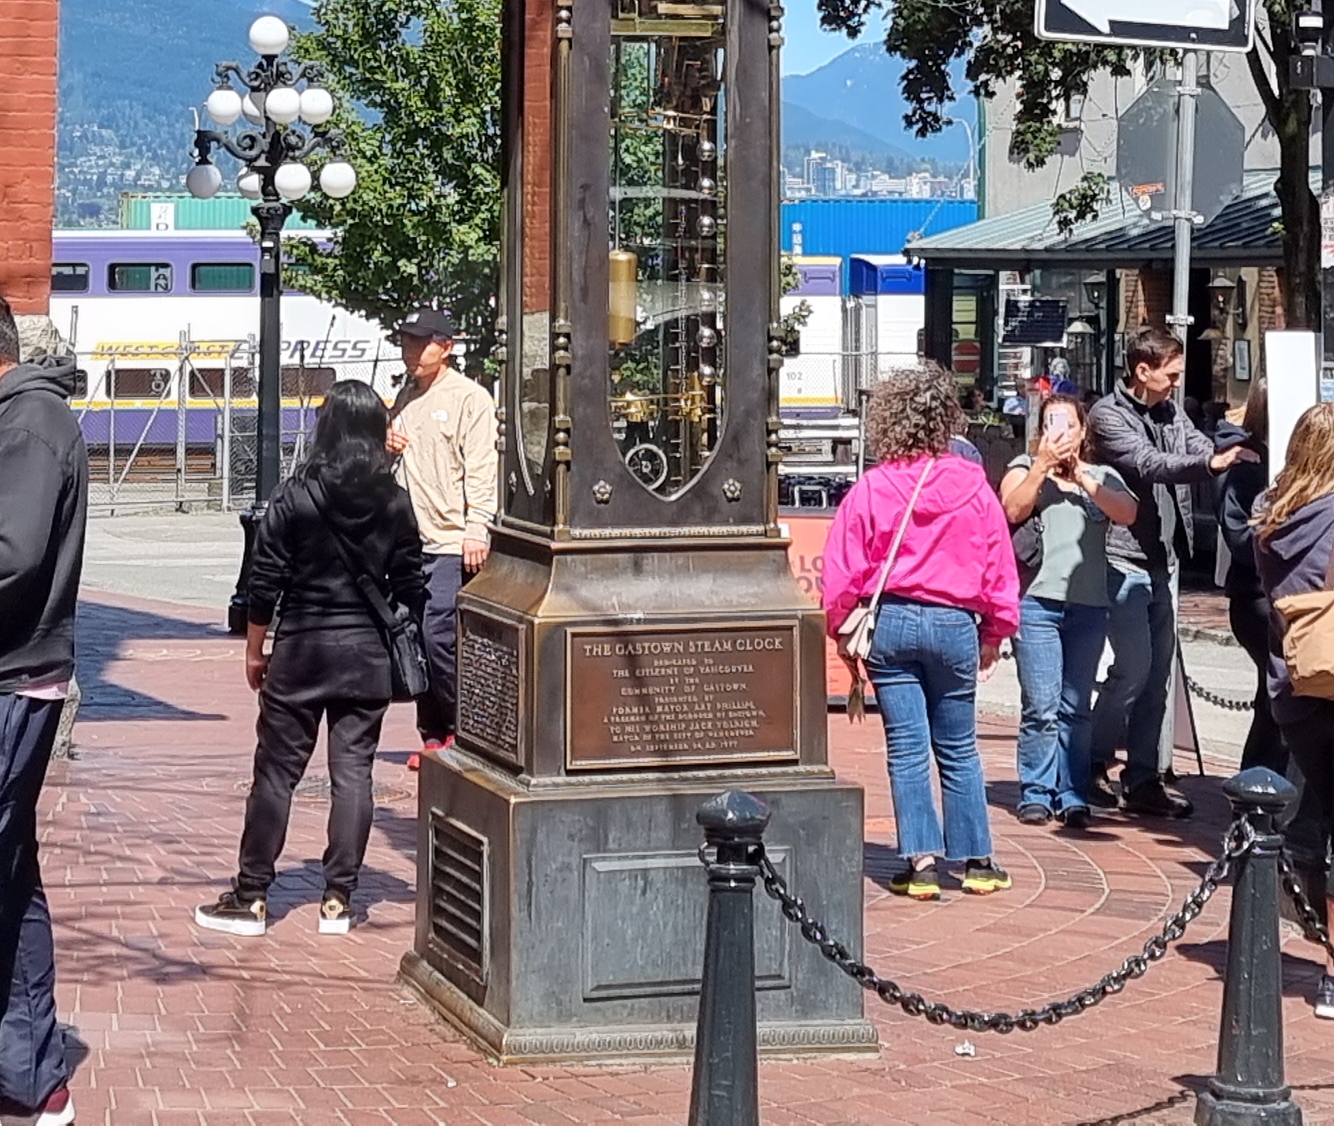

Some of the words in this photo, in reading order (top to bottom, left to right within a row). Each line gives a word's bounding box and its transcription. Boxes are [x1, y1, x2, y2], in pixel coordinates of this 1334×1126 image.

[229, 339, 370, 360] EPRESS
[584, 644, 612, 657] THE
[615, 641, 684, 657] GASTOWN
[688, 639, 733, 654] STEAM
[735, 637, 784, 652] CLOCK
[698, 664, 755, 674] VANCOUVER
[620, 685, 676, 696] COMMUNITY
